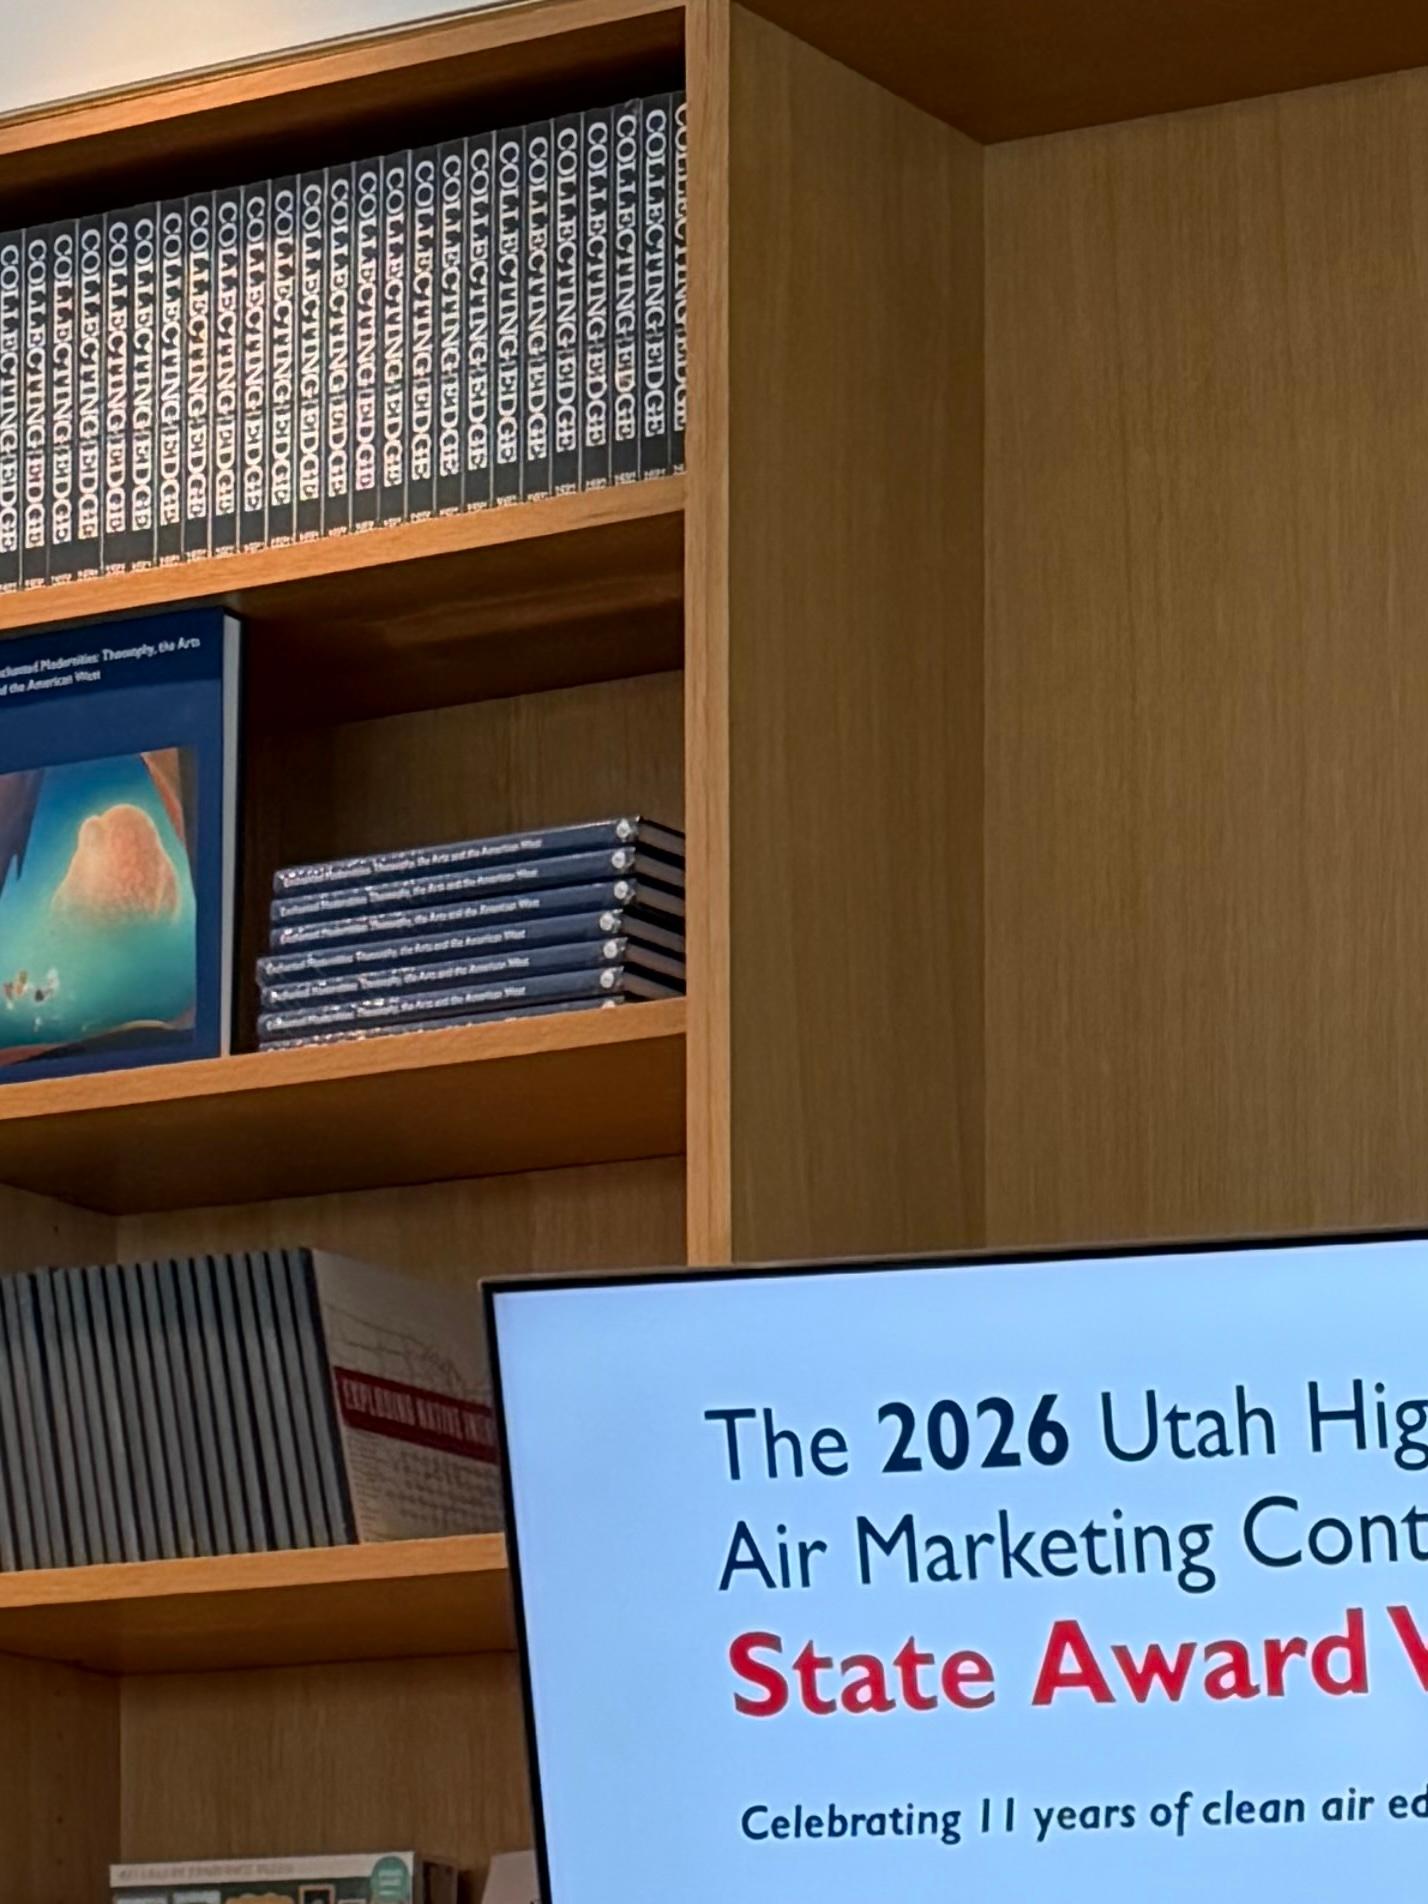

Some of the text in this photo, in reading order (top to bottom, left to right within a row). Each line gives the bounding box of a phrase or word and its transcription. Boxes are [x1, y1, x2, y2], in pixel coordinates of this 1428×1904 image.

[705, 1408, 848, 1480] The
[878, 1394, 1068, 1472] 2026
[1102, 1385, 1275, 1462] Utah
[719, 1521, 827, 1590] Air
[857, 1509, 1215, 1593] Marketing
[730, 1632, 994, 1716] State
[1032, 1608, 1368, 1705] Award
[742, 1803, 961, 1845] Celebrating
[982, 1798, 1014, 1832] 11
[1034, 1800, 1136, 1842] years
[1150, 1791, 1193, 1836] of
[1203, 1790, 1304, 1825] clean
[1322, 1788, 1374, 1821] air
